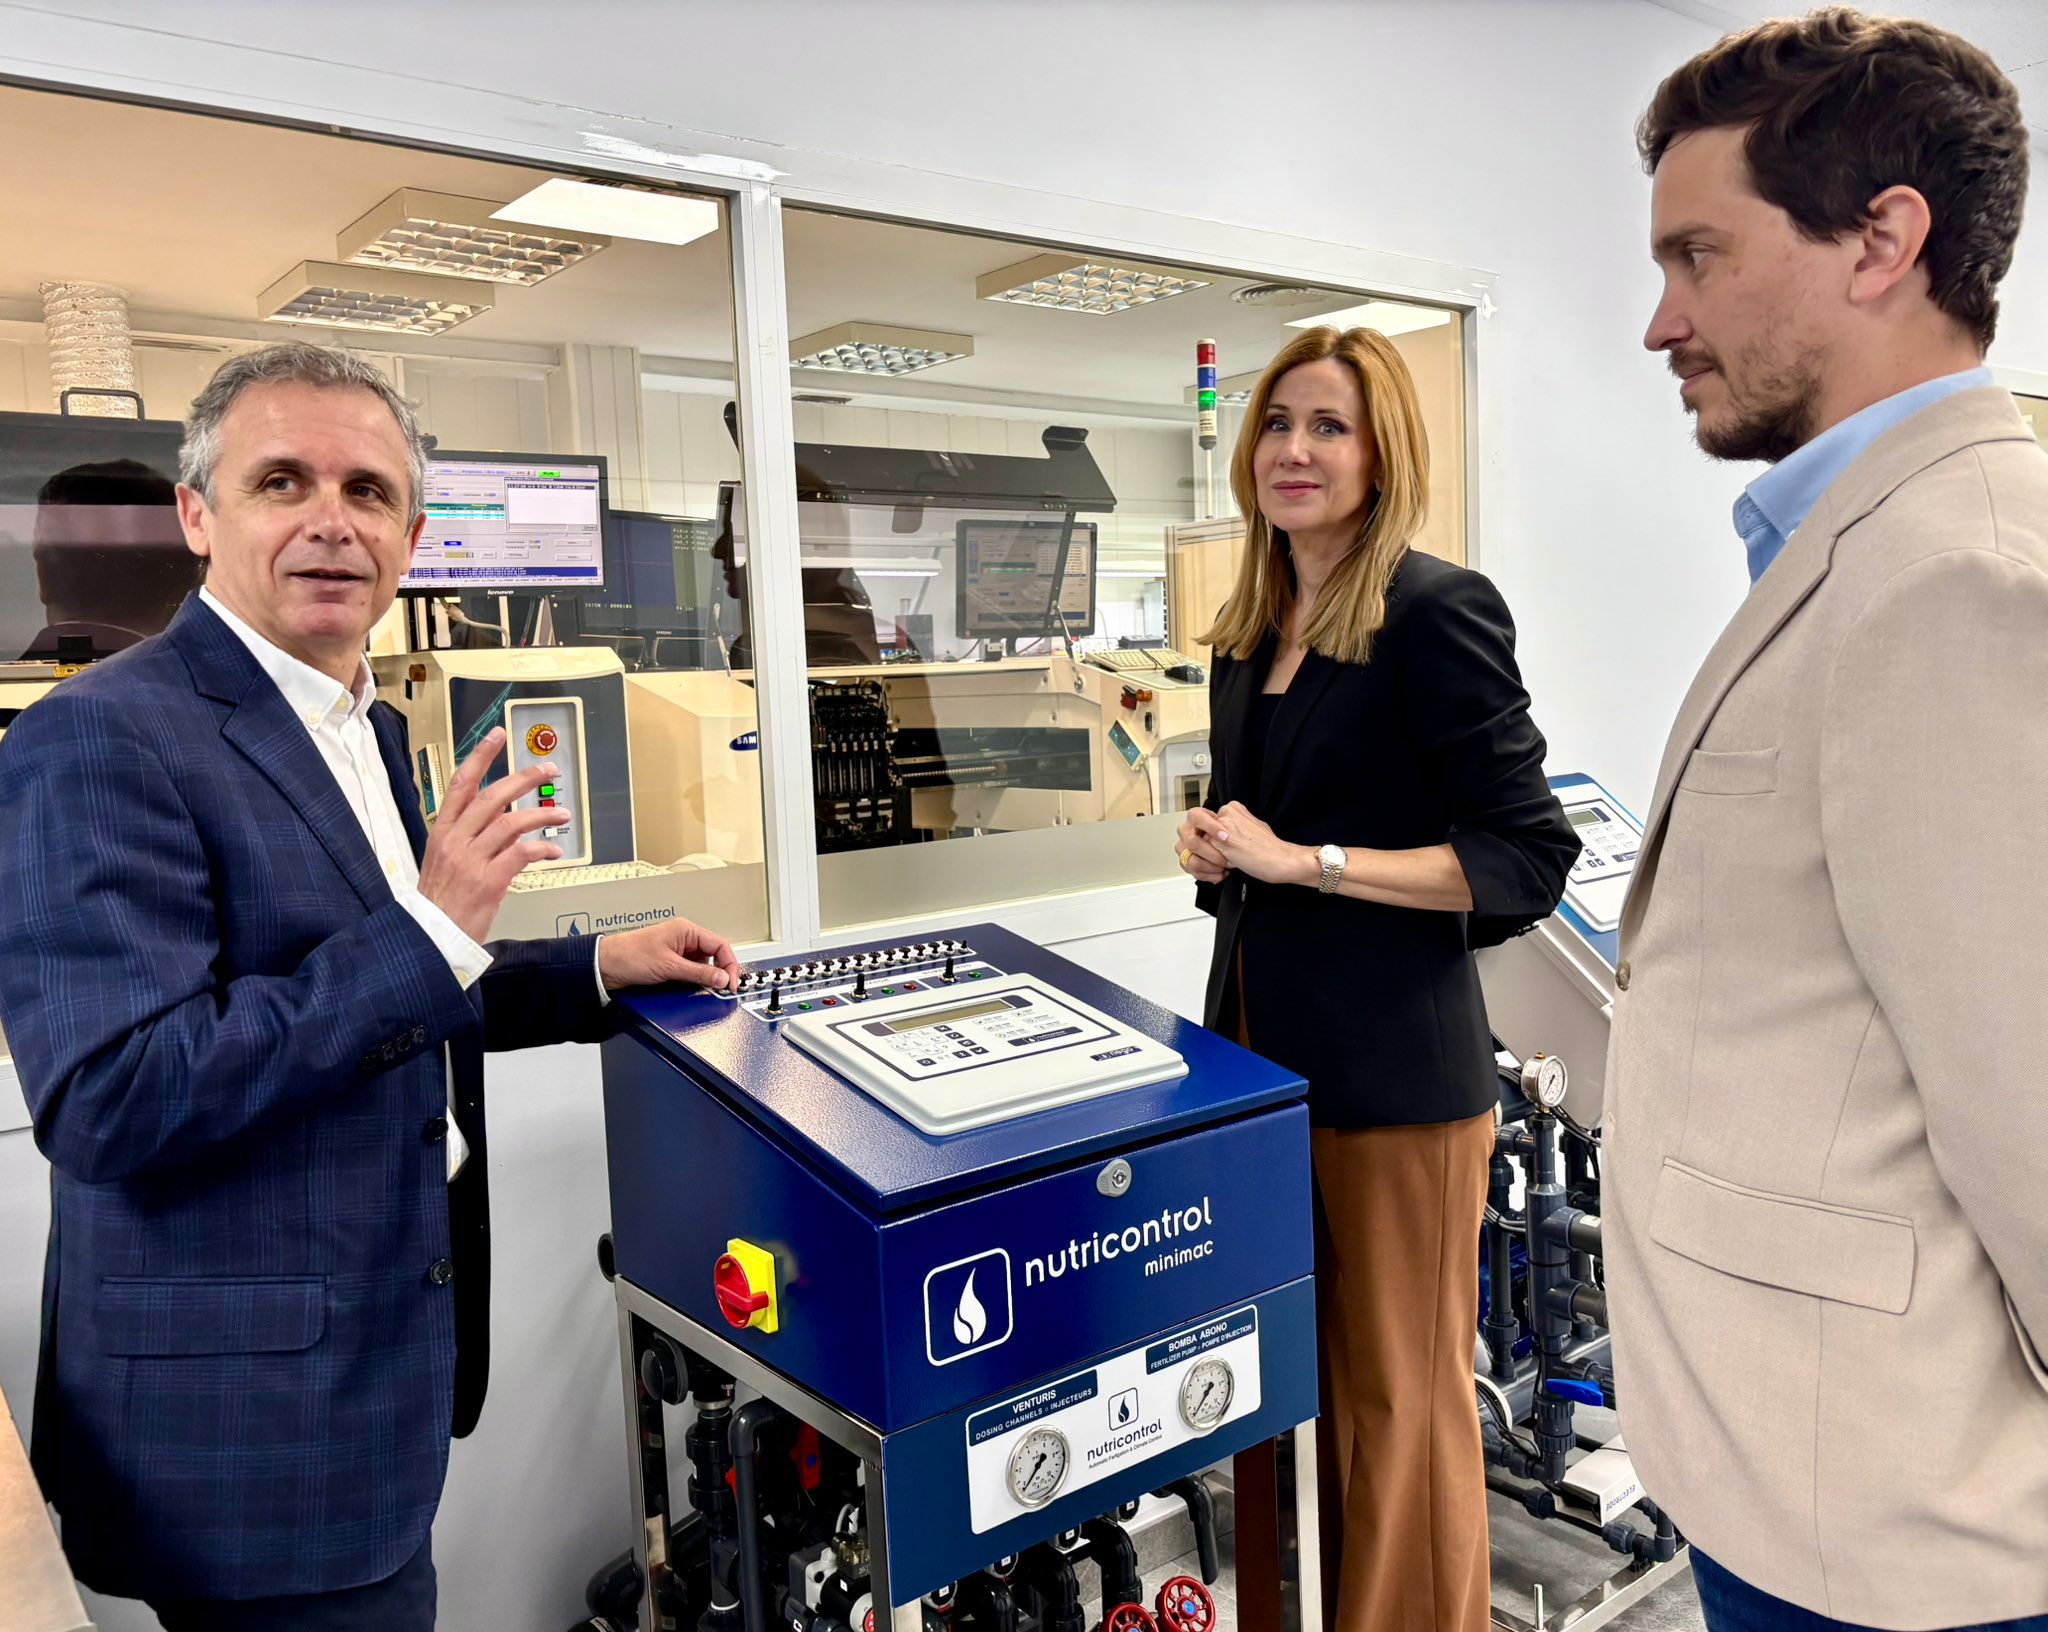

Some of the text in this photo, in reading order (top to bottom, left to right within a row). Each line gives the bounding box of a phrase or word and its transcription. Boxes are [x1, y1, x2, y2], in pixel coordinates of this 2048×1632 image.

[595, 906, 676, 928] nutricontrol
[1025, 1196, 1213, 1287] nutricontrol
[1144, 1238, 1214, 1277] minimac
[1150, 1353, 1181, 1370] FERTILIZER
[1181, 1345, 1197, 1357] PUMP
[1201, 1336, 1220, 1349] POMPE
[1168, 1322, 1228, 1352] BOMBA ABONO
[975, 1388, 1092, 1440] DOSING CHANNELS INJECTEURS
[1012, 1389, 1057, 1414] VENTURIS
[1087, 1418, 1162, 1461] nutricontrol
